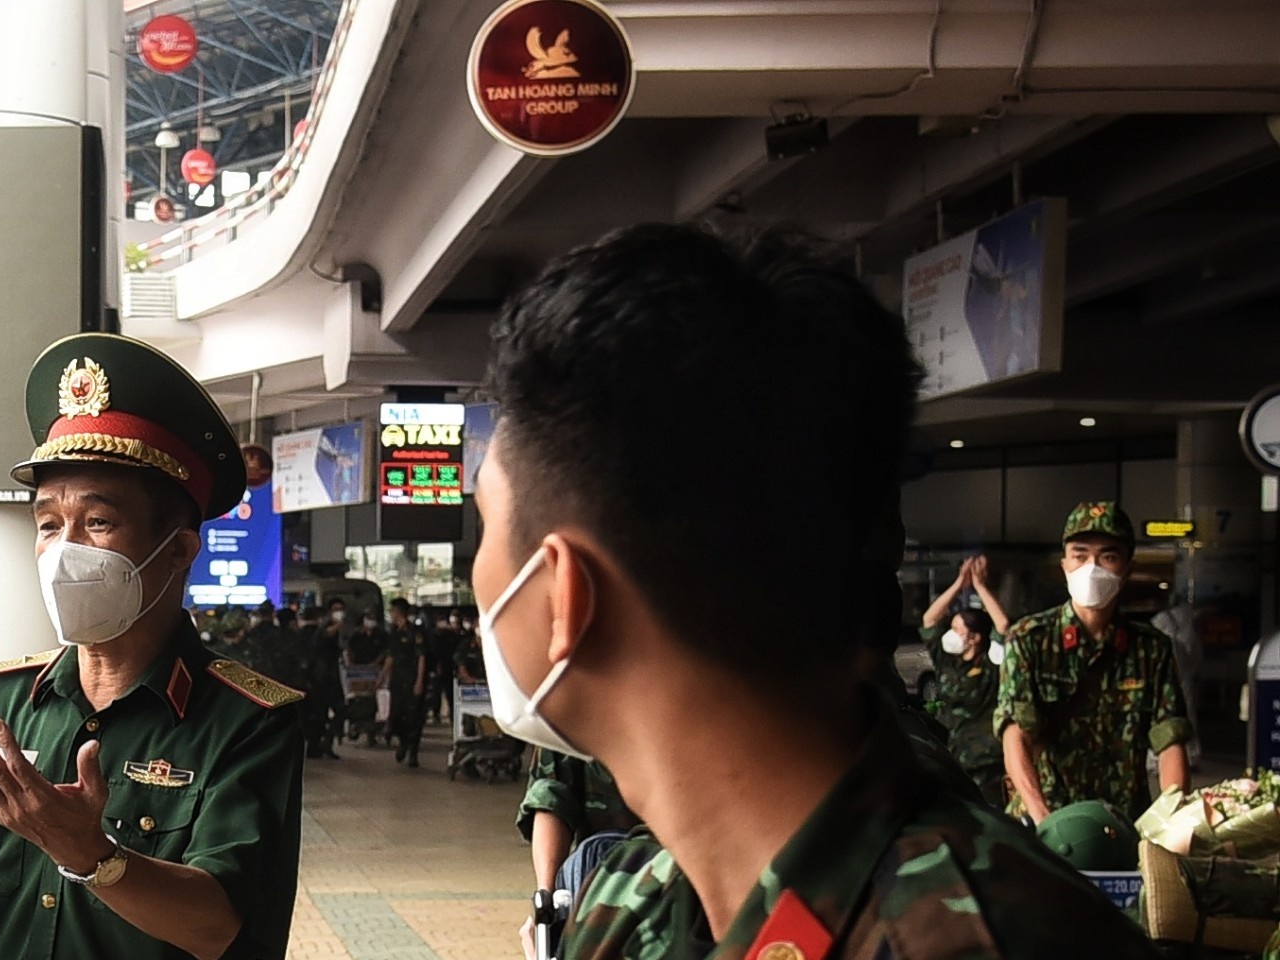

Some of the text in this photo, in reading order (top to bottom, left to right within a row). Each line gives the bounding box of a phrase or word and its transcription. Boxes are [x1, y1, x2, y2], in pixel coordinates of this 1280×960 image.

[486, 82, 618, 101] TAN HOANG MINH
[526, 101, 579, 115] GROUP
[403, 424, 462, 446] TAXI
